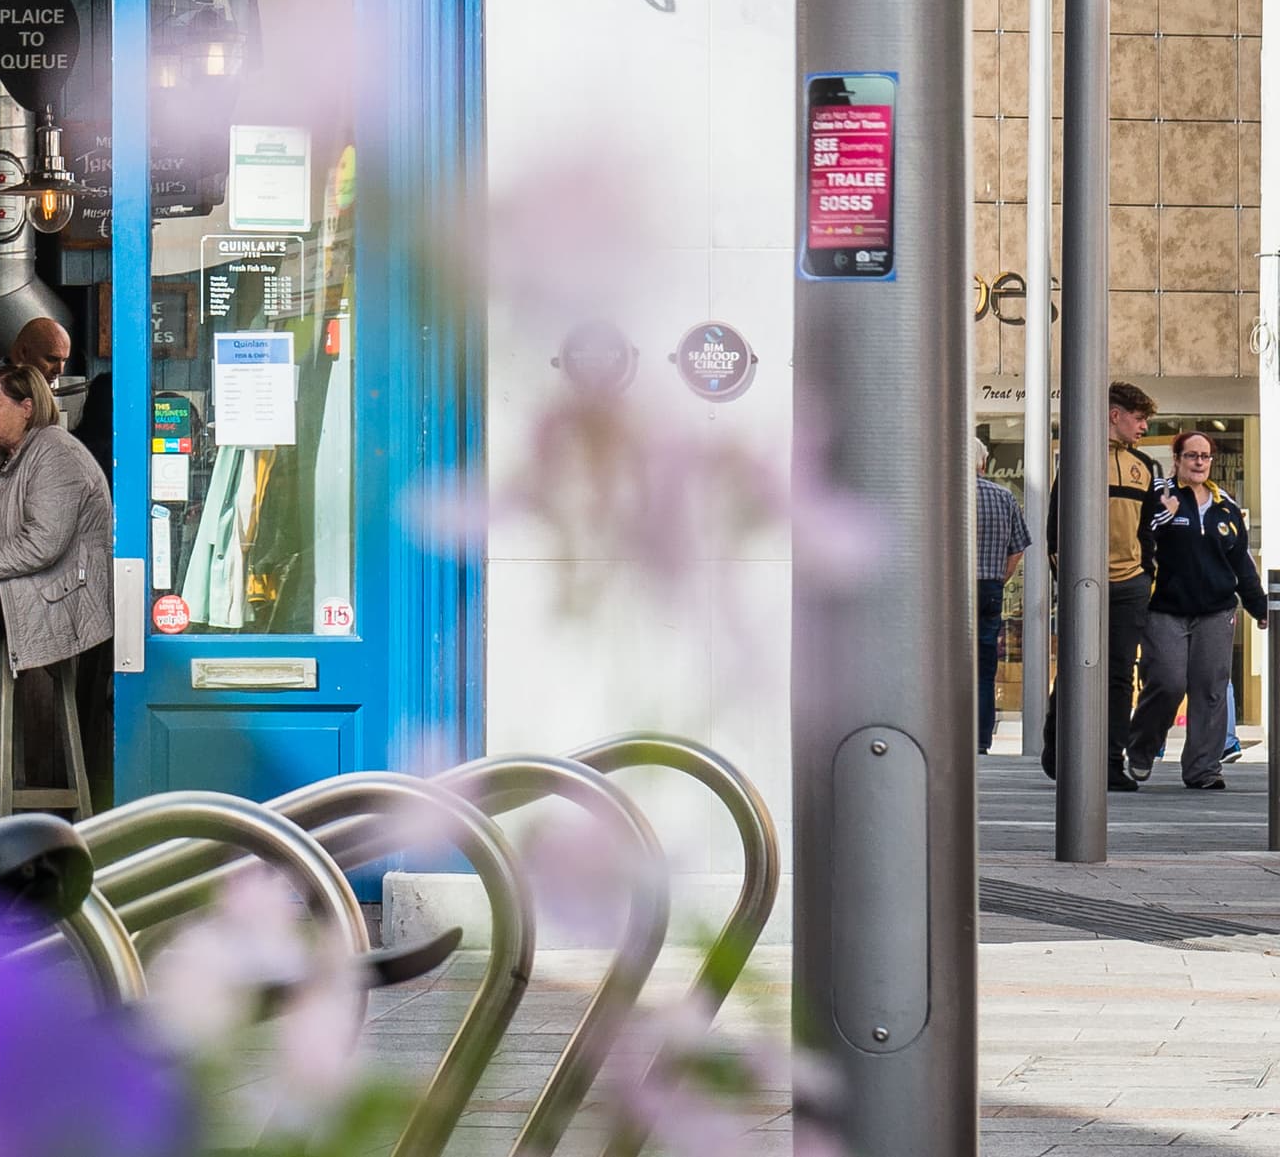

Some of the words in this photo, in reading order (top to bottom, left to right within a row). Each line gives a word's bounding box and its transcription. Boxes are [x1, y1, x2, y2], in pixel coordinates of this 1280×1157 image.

[0, 8, 65, 23] PLAICE
[19, 32, 44, 46] TO
[0, 54, 68, 69] QUEUE
[814, 138, 839, 152] SEE
[814, 153, 840, 167] SAY
[826, 172, 887, 187] TRALEE
[219, 241, 286, 252] QUINLAN'S
[688, 351, 740, 361] SEAFOOD
[694, 360, 734, 369] CIRCLE
[982, 385, 1012, 399] Treat
